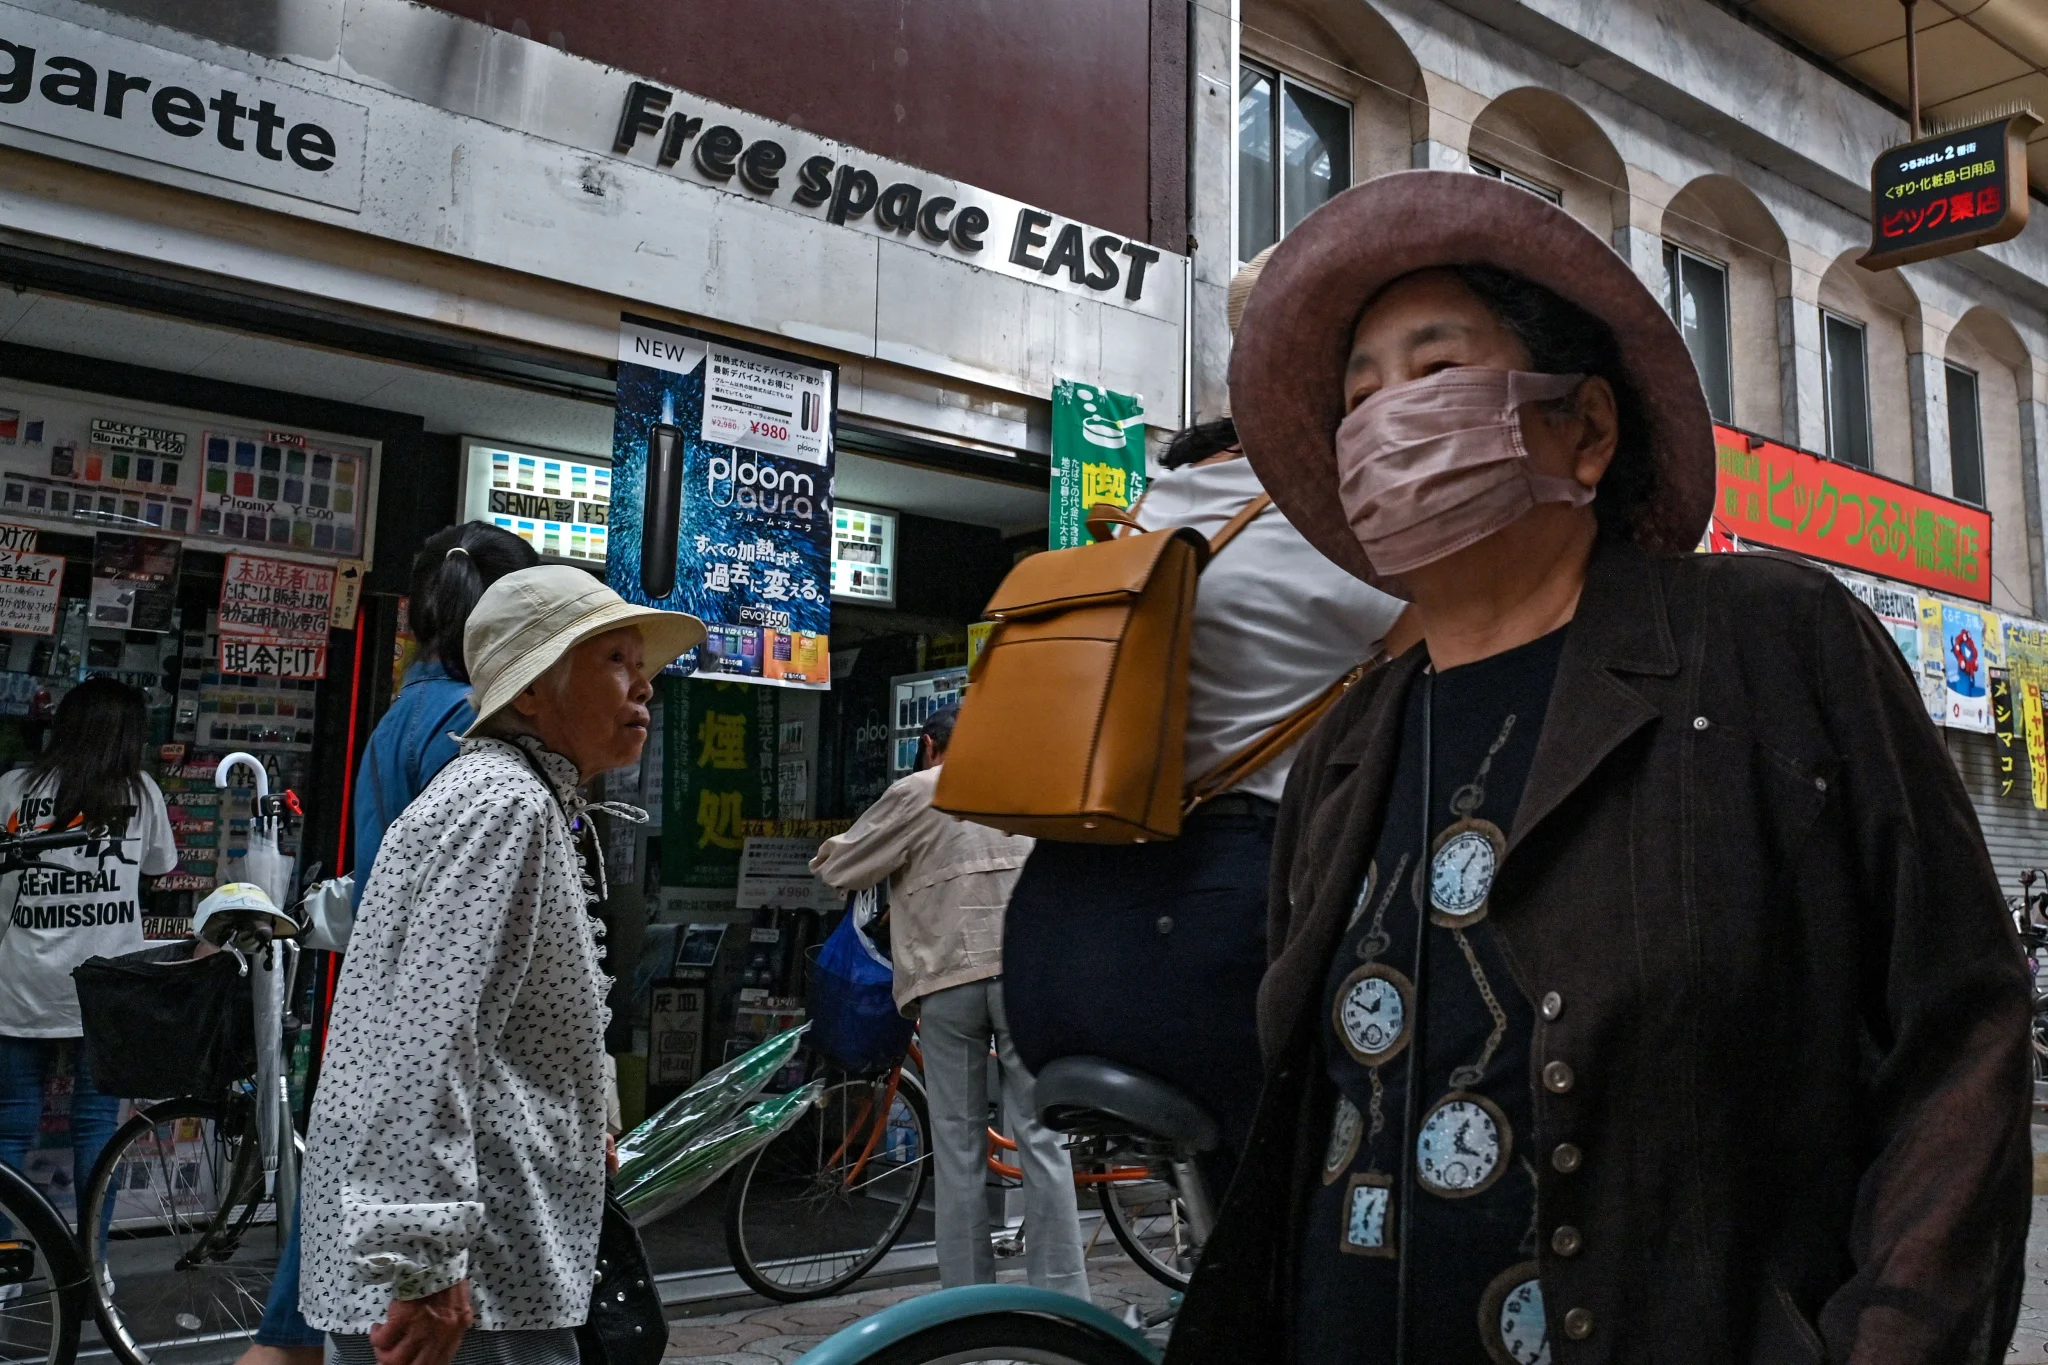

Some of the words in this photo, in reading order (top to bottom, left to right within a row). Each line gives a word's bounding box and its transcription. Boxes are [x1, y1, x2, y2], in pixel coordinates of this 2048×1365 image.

[613, 81, 788, 193] Free
[793, 154, 990, 252] space
[1009, 208, 1160, 301] EAST
[1884, 159, 1996, 199] くすり・化粧品・日用品
[635, 337, 685, 363] NEW
[711, 418, 737, 431] ¥2,980
[750, 420, 788, 441] ¥980
[797, 442, 820, 455] ploom
[709, 449, 814, 508] ploom
[583, 502, 609, 524] ¥5
[736, 486, 813, 521] aura
[1069, 458, 1080, 549] たばこの代金に含ま
[735, 512, 812, 533] ブルーム・オーラ
[693, 534, 804, 569] すべての加熱式を、
[236, 559, 329, 592] 未成年者には
[704, 561, 825, 604] 過去に変える。
[224, 579, 329, 610] たばこは販売しません
[222, 602, 328, 633] 身分証明書が必要です
[741, 609, 763, 621] evo
[762, 611, 789, 629] ¥550
[224, 643, 325, 677] 現金だけ!
[1994, 681, 2014, 798] メシマコブ
[2028, 683, 2046, 802] ローヤルゼリー
[18, 793, 57, 827] jus
[20, 868, 121, 896] GENERAL
[778, 886, 810, 898] ¥980
[13, 900, 135, 930] ADMISSION
